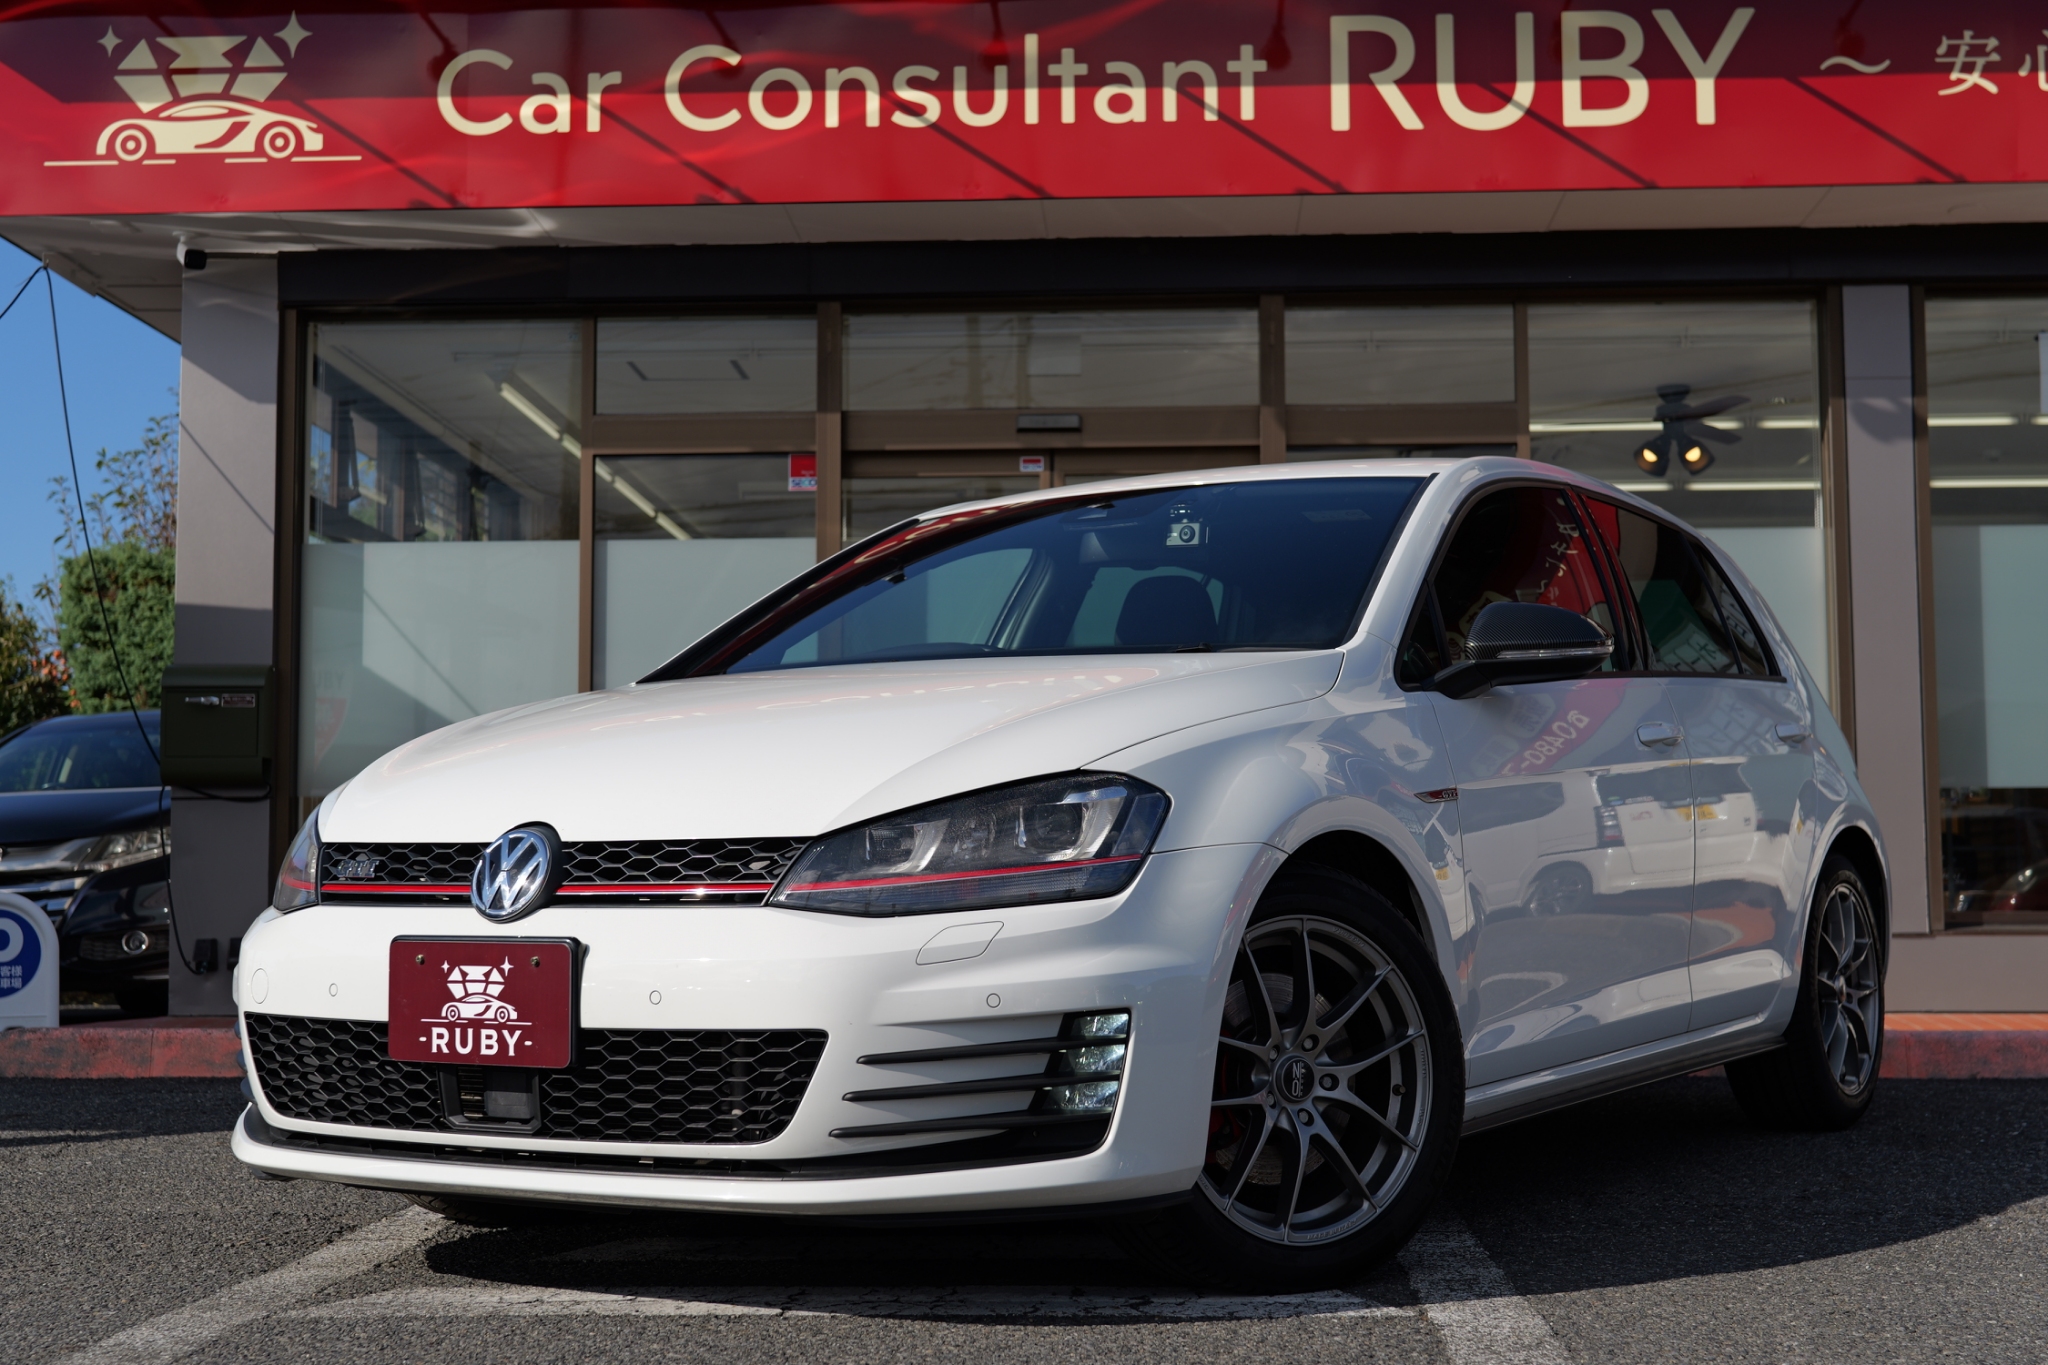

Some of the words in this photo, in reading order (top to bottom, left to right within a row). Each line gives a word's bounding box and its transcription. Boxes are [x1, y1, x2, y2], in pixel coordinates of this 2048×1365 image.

[436, 48, 622, 136] Car
[664, 33, 1268, 132] Consultant
[1329, 7, 1756, 132] RUBY
